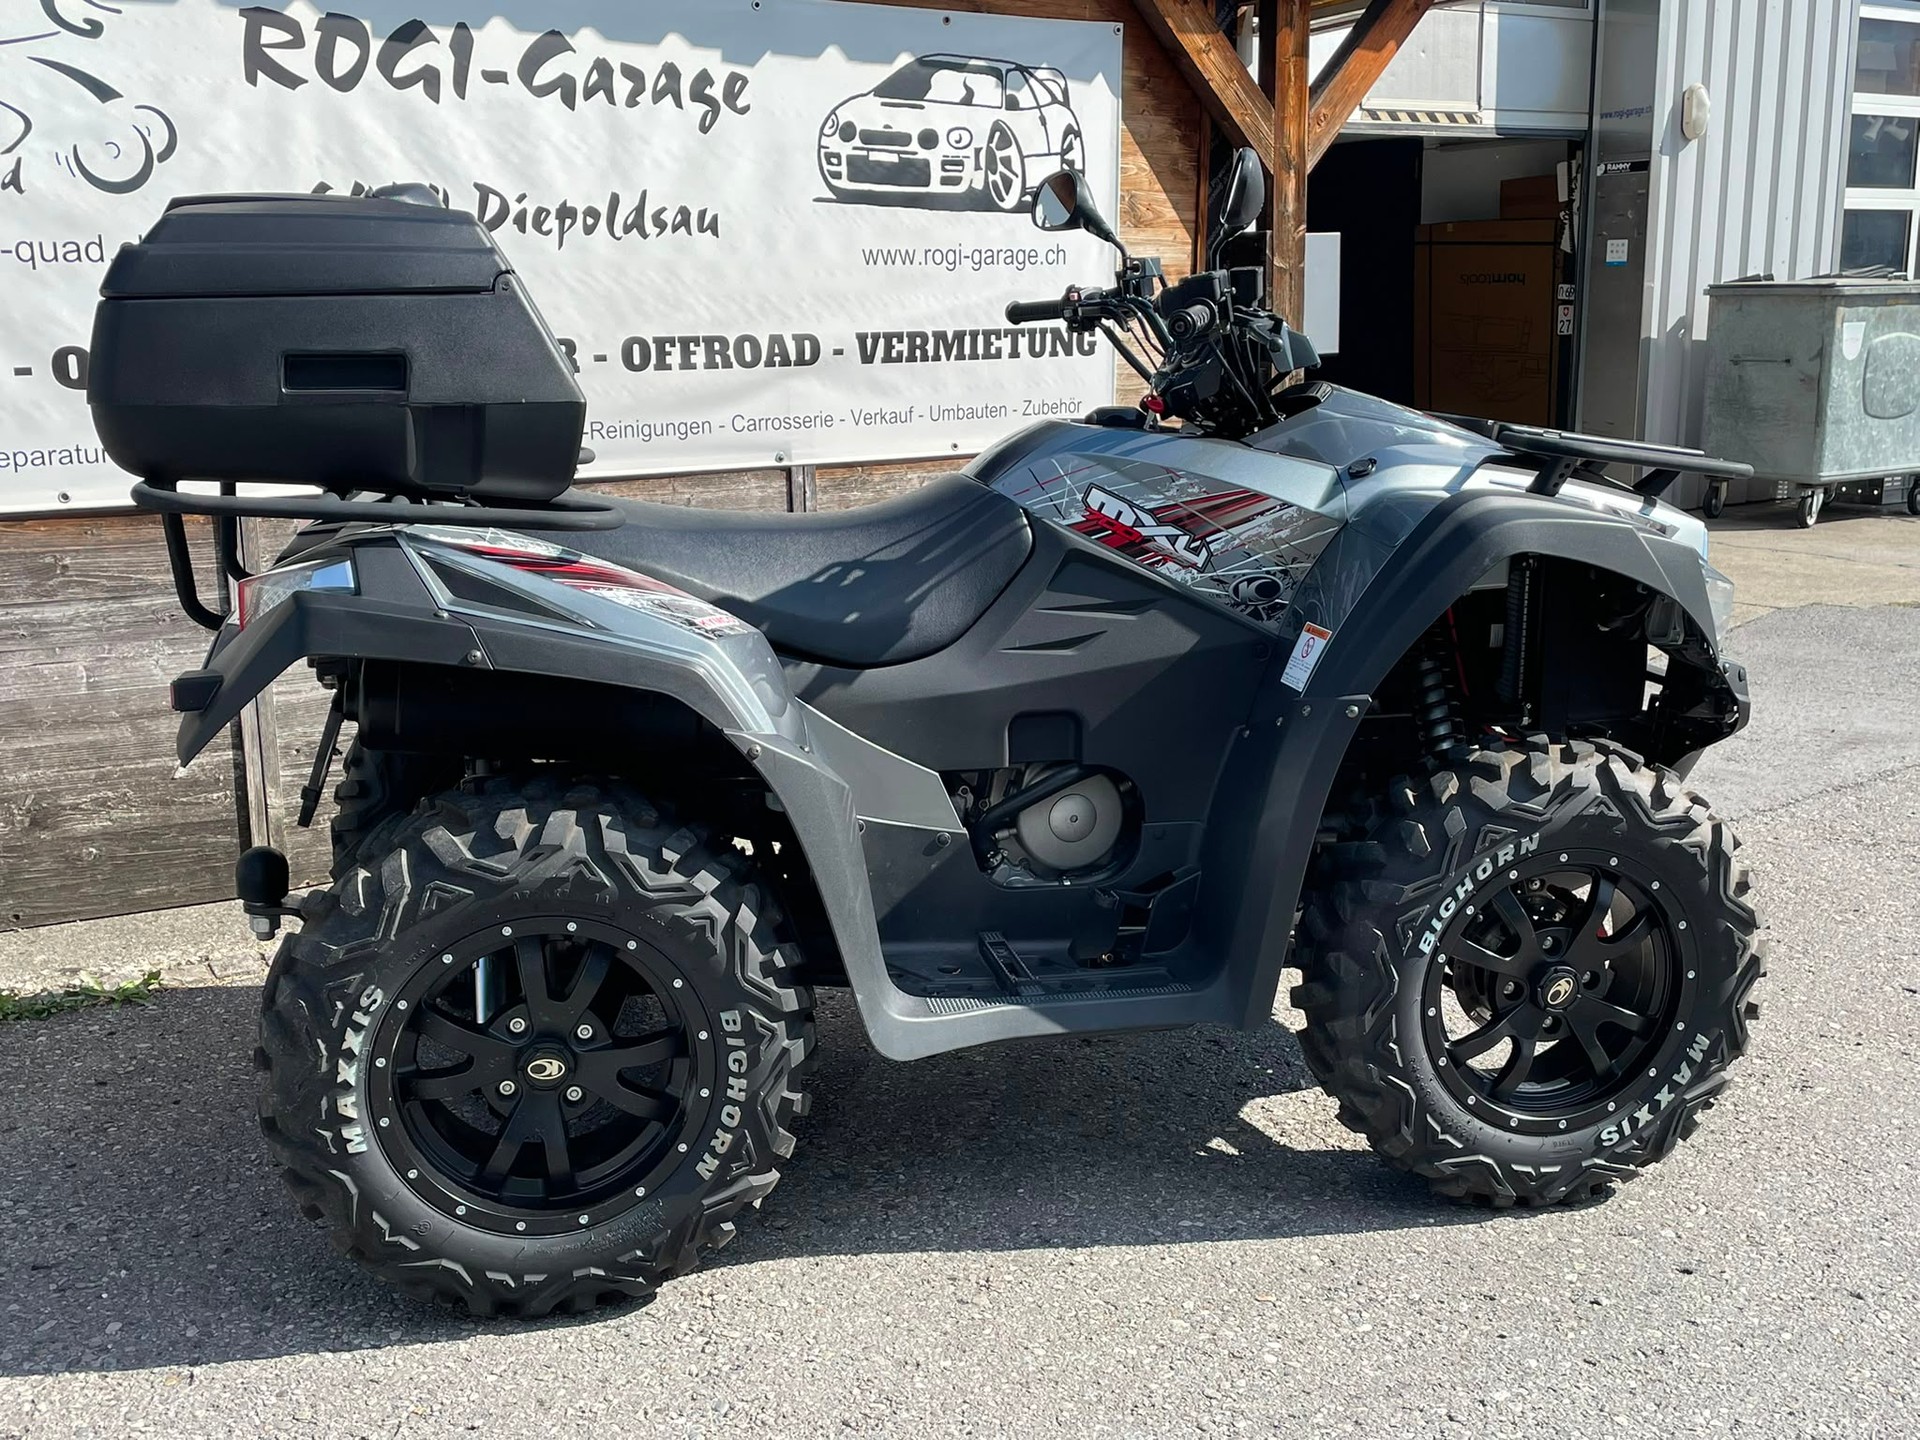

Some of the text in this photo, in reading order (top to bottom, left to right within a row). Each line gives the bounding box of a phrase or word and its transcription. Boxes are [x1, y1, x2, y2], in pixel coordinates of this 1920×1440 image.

[239, 6, 750, 135] ROGI-Garage
[473, 181, 719, 250] Diepoldsau
[862, 243, 1067, 271] www.rogi-garage.ch
[621, 333, 821, 373] OFFROAD
[855, 327, 1097, 364] VERMIETUNG
[1559, 319, 1572, 333] 27
[731, 410, 834, 433] Carrosserie
[850, 405, 915, 426] Verkauf
[929, 402, 1008, 422] Umbauten
[1022, 397, 1083, 416] Zubehör
[1418, 832, 1540, 955] BIGHORN
[336, 985, 385, 1155] MAXXIS
[695, 1010, 748, 1182] BIGHORN
[1599, 1033, 1711, 1147] MAXXIS
